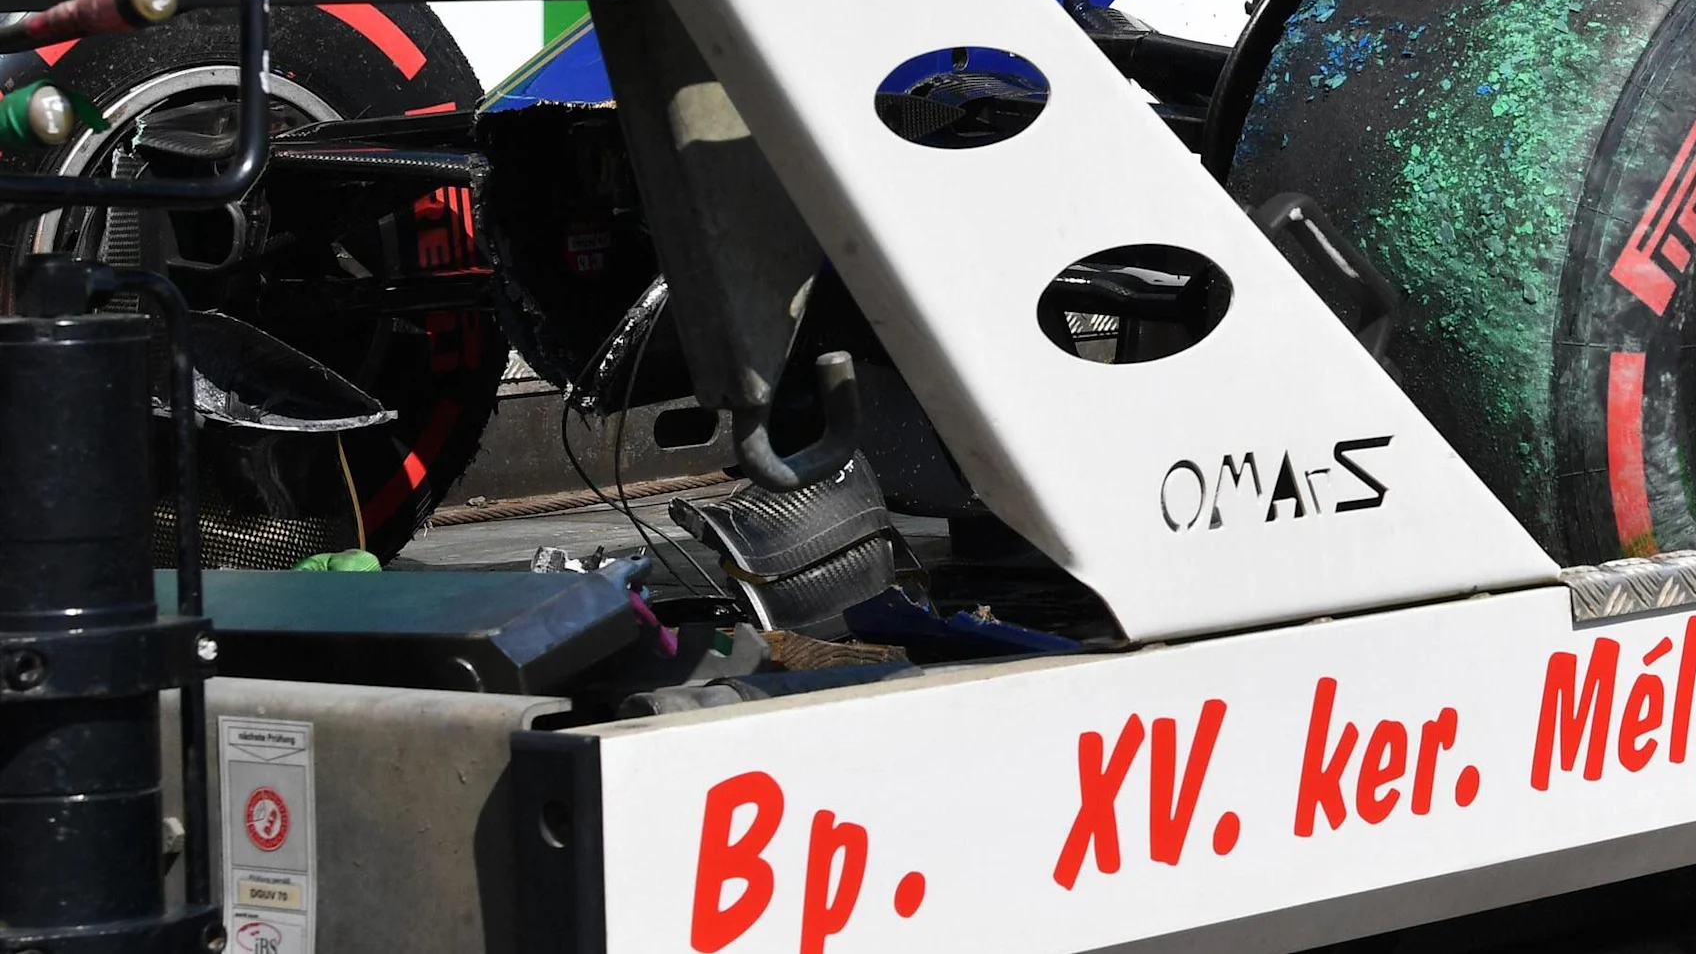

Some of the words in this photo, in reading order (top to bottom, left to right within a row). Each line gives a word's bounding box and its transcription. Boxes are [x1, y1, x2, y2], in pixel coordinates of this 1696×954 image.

[689, 770, 927, 954] Bp.
[1053, 698, 1241, 891] XV.
[1294, 676, 1480, 838] ker.
